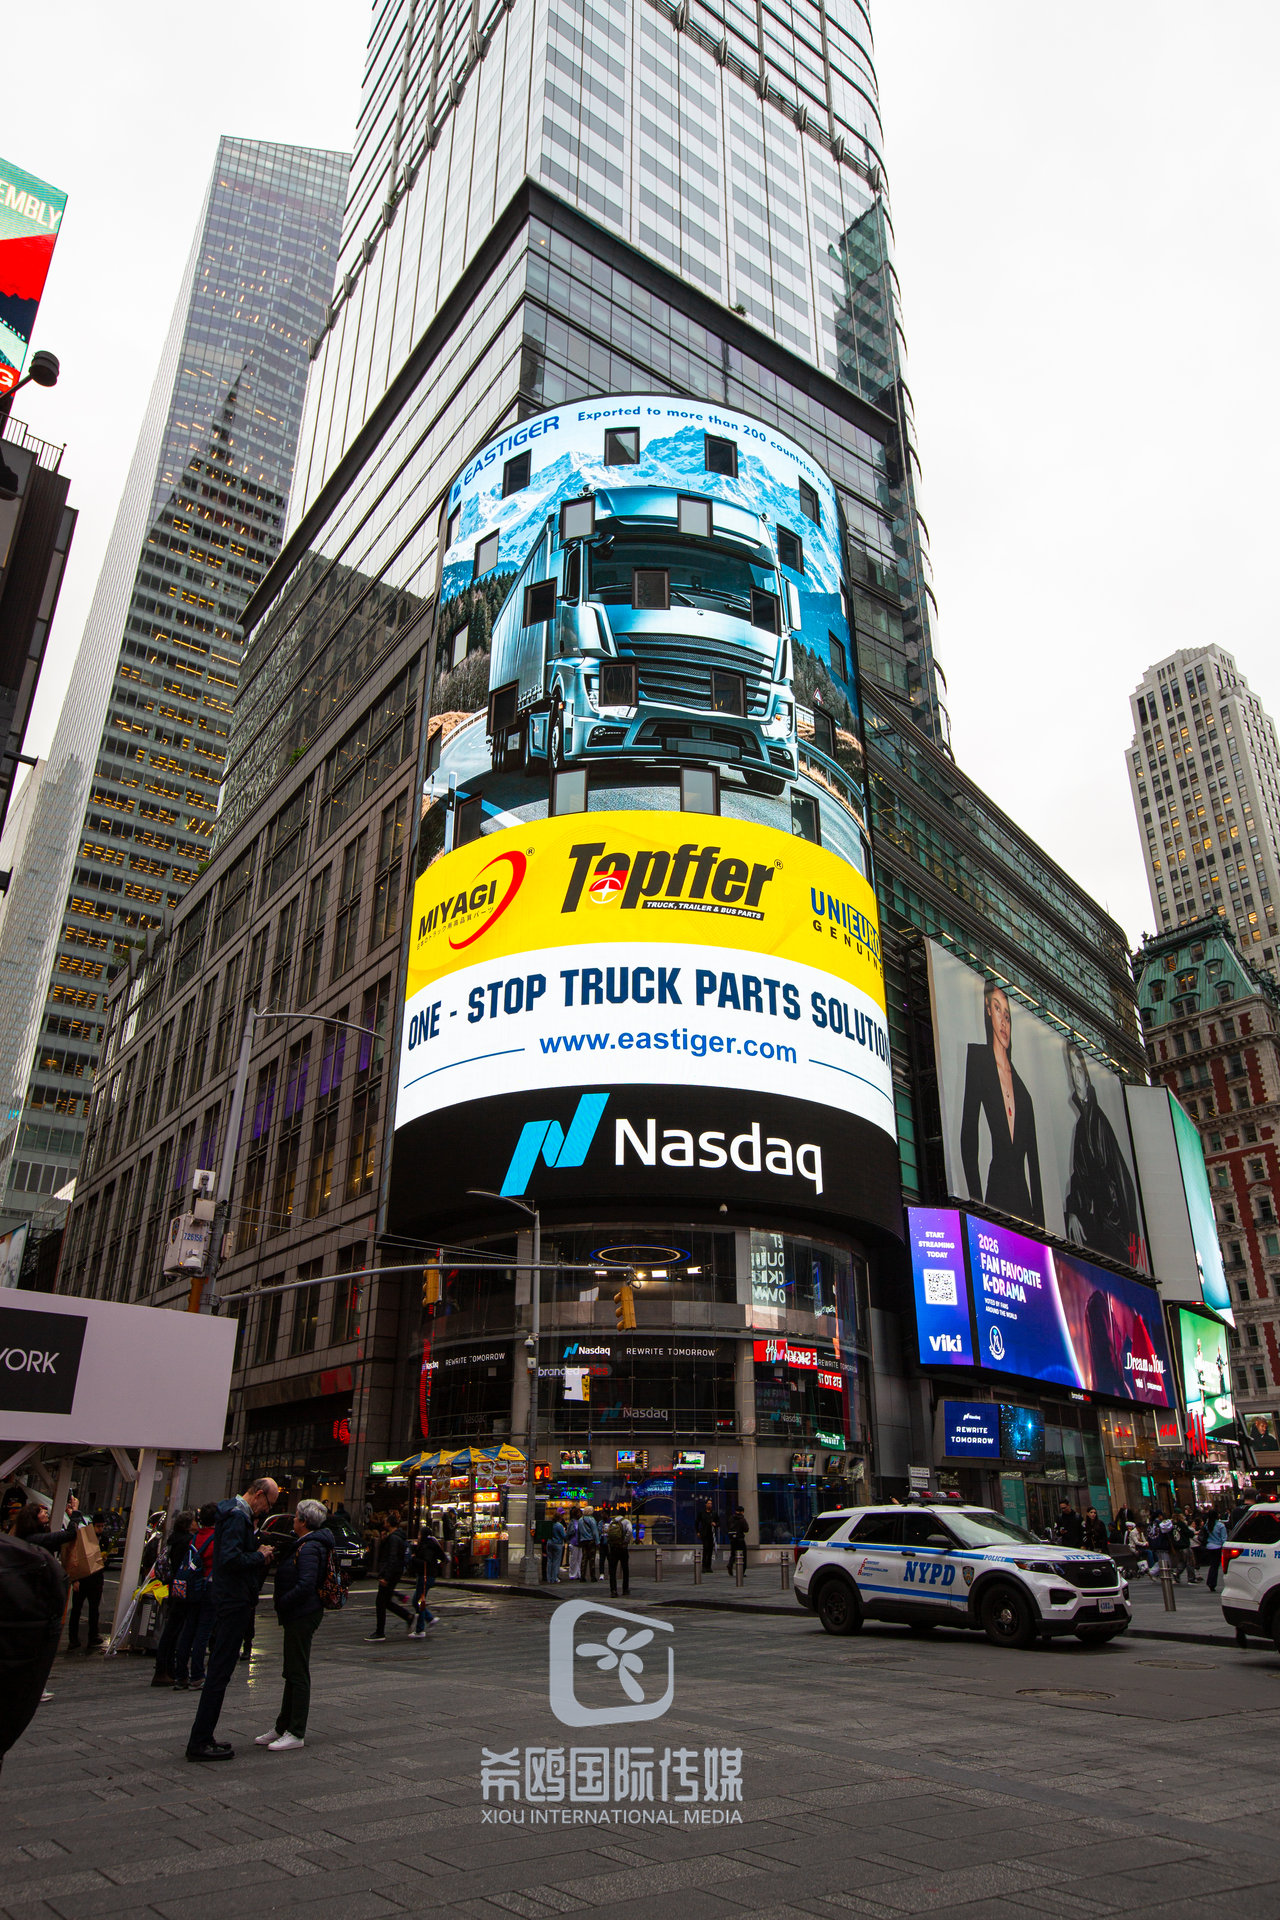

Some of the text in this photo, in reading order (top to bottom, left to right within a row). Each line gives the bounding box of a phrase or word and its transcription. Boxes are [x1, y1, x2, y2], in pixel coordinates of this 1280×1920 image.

[464, 416, 560, 486] EASTIGER
[578, 406, 830, 495] Exported to more than 200 countries and
[418, 880, 497, 941] MIYAGI
[646, 901, 677, 909] TRUCK,
[678, 903, 712, 912] TRAILER
[721, 907, 736, 915] BUS
[737, 910, 761, 919] PARTS
[813, 920, 883, 978] GENUINE
[408, 1000, 441, 1051] ONE
[468, 973, 546, 1023] STOP
[560, 966, 682, 1006] TRUCK
[696, 969, 800, 1020] PARTS
[540, 1028, 797, 1063] www.eastiger.com
[614, 1118, 823, 1196] Nasdaq
[918, 1241, 955, 1249] STREAMING
[978, 1233, 999, 1254] 2026
[980, 1252, 1042, 1289] FAN FAVORITE
[982, 1273, 1026, 1303] K-DRAMA
[445, 1352, 505, 1366] REWRITE TOMORROW
[578, 1345, 611, 1356] Nasdaq
[626, 1347, 715, 1356] REWRITE TOMORROW
[1124, 1352, 1148, 1371] Dream
[623, 1407, 668, 1421] Nasdaq
[951, 1436, 994, 1444] TOMORROW
[956, 1426, 988, 1434] REWRITE
[904, 1561, 955, 1586] NYPD
